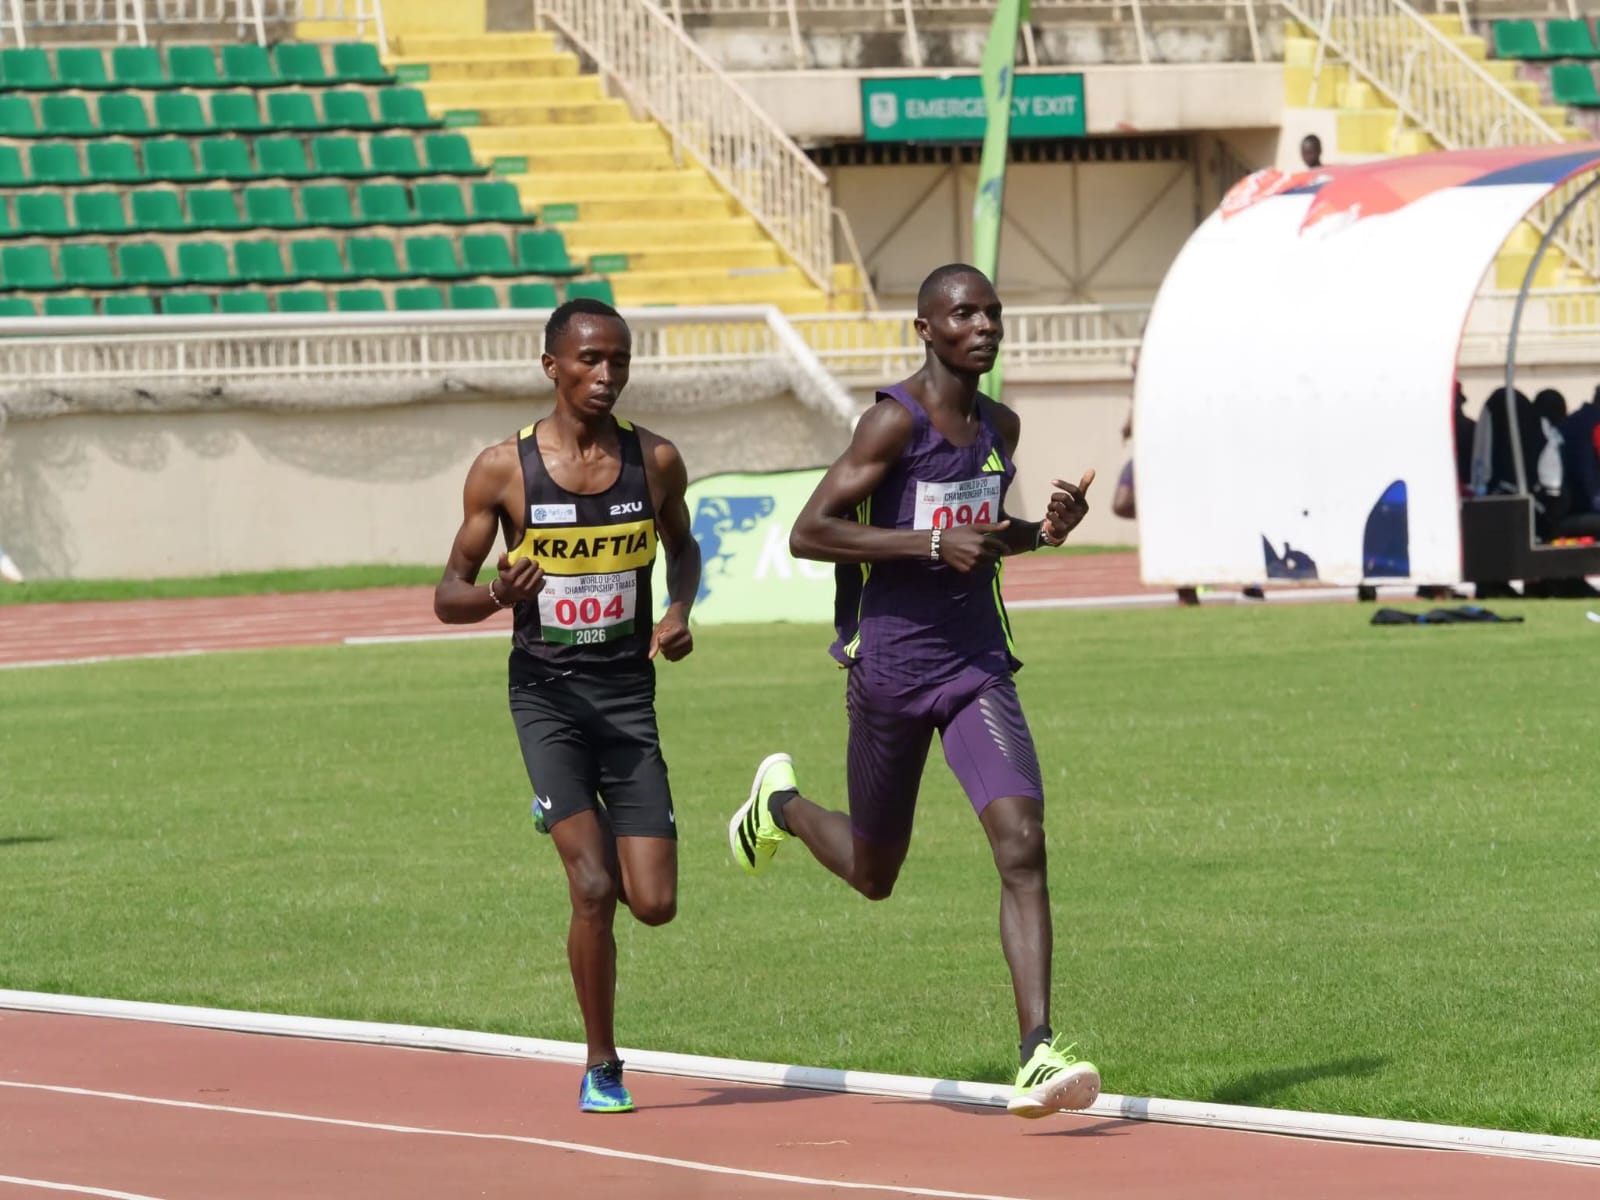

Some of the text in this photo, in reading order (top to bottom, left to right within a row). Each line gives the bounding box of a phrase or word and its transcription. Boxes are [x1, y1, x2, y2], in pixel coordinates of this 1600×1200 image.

[905, 95, 1077, 119] EMERGEY EXIT
[609, 501, 643, 516] 2XU
[932, 501, 991, 529] 094
[533, 531, 648, 559] KRAFTIA
[564, 583, 615, 595] CHAMPIONSHIP
[615, 580, 636, 591] TRIALS
[580, 574, 621, 585] WORLD U-20
[555, 594, 624, 625] 004
[576, 629, 606, 645] 2026
